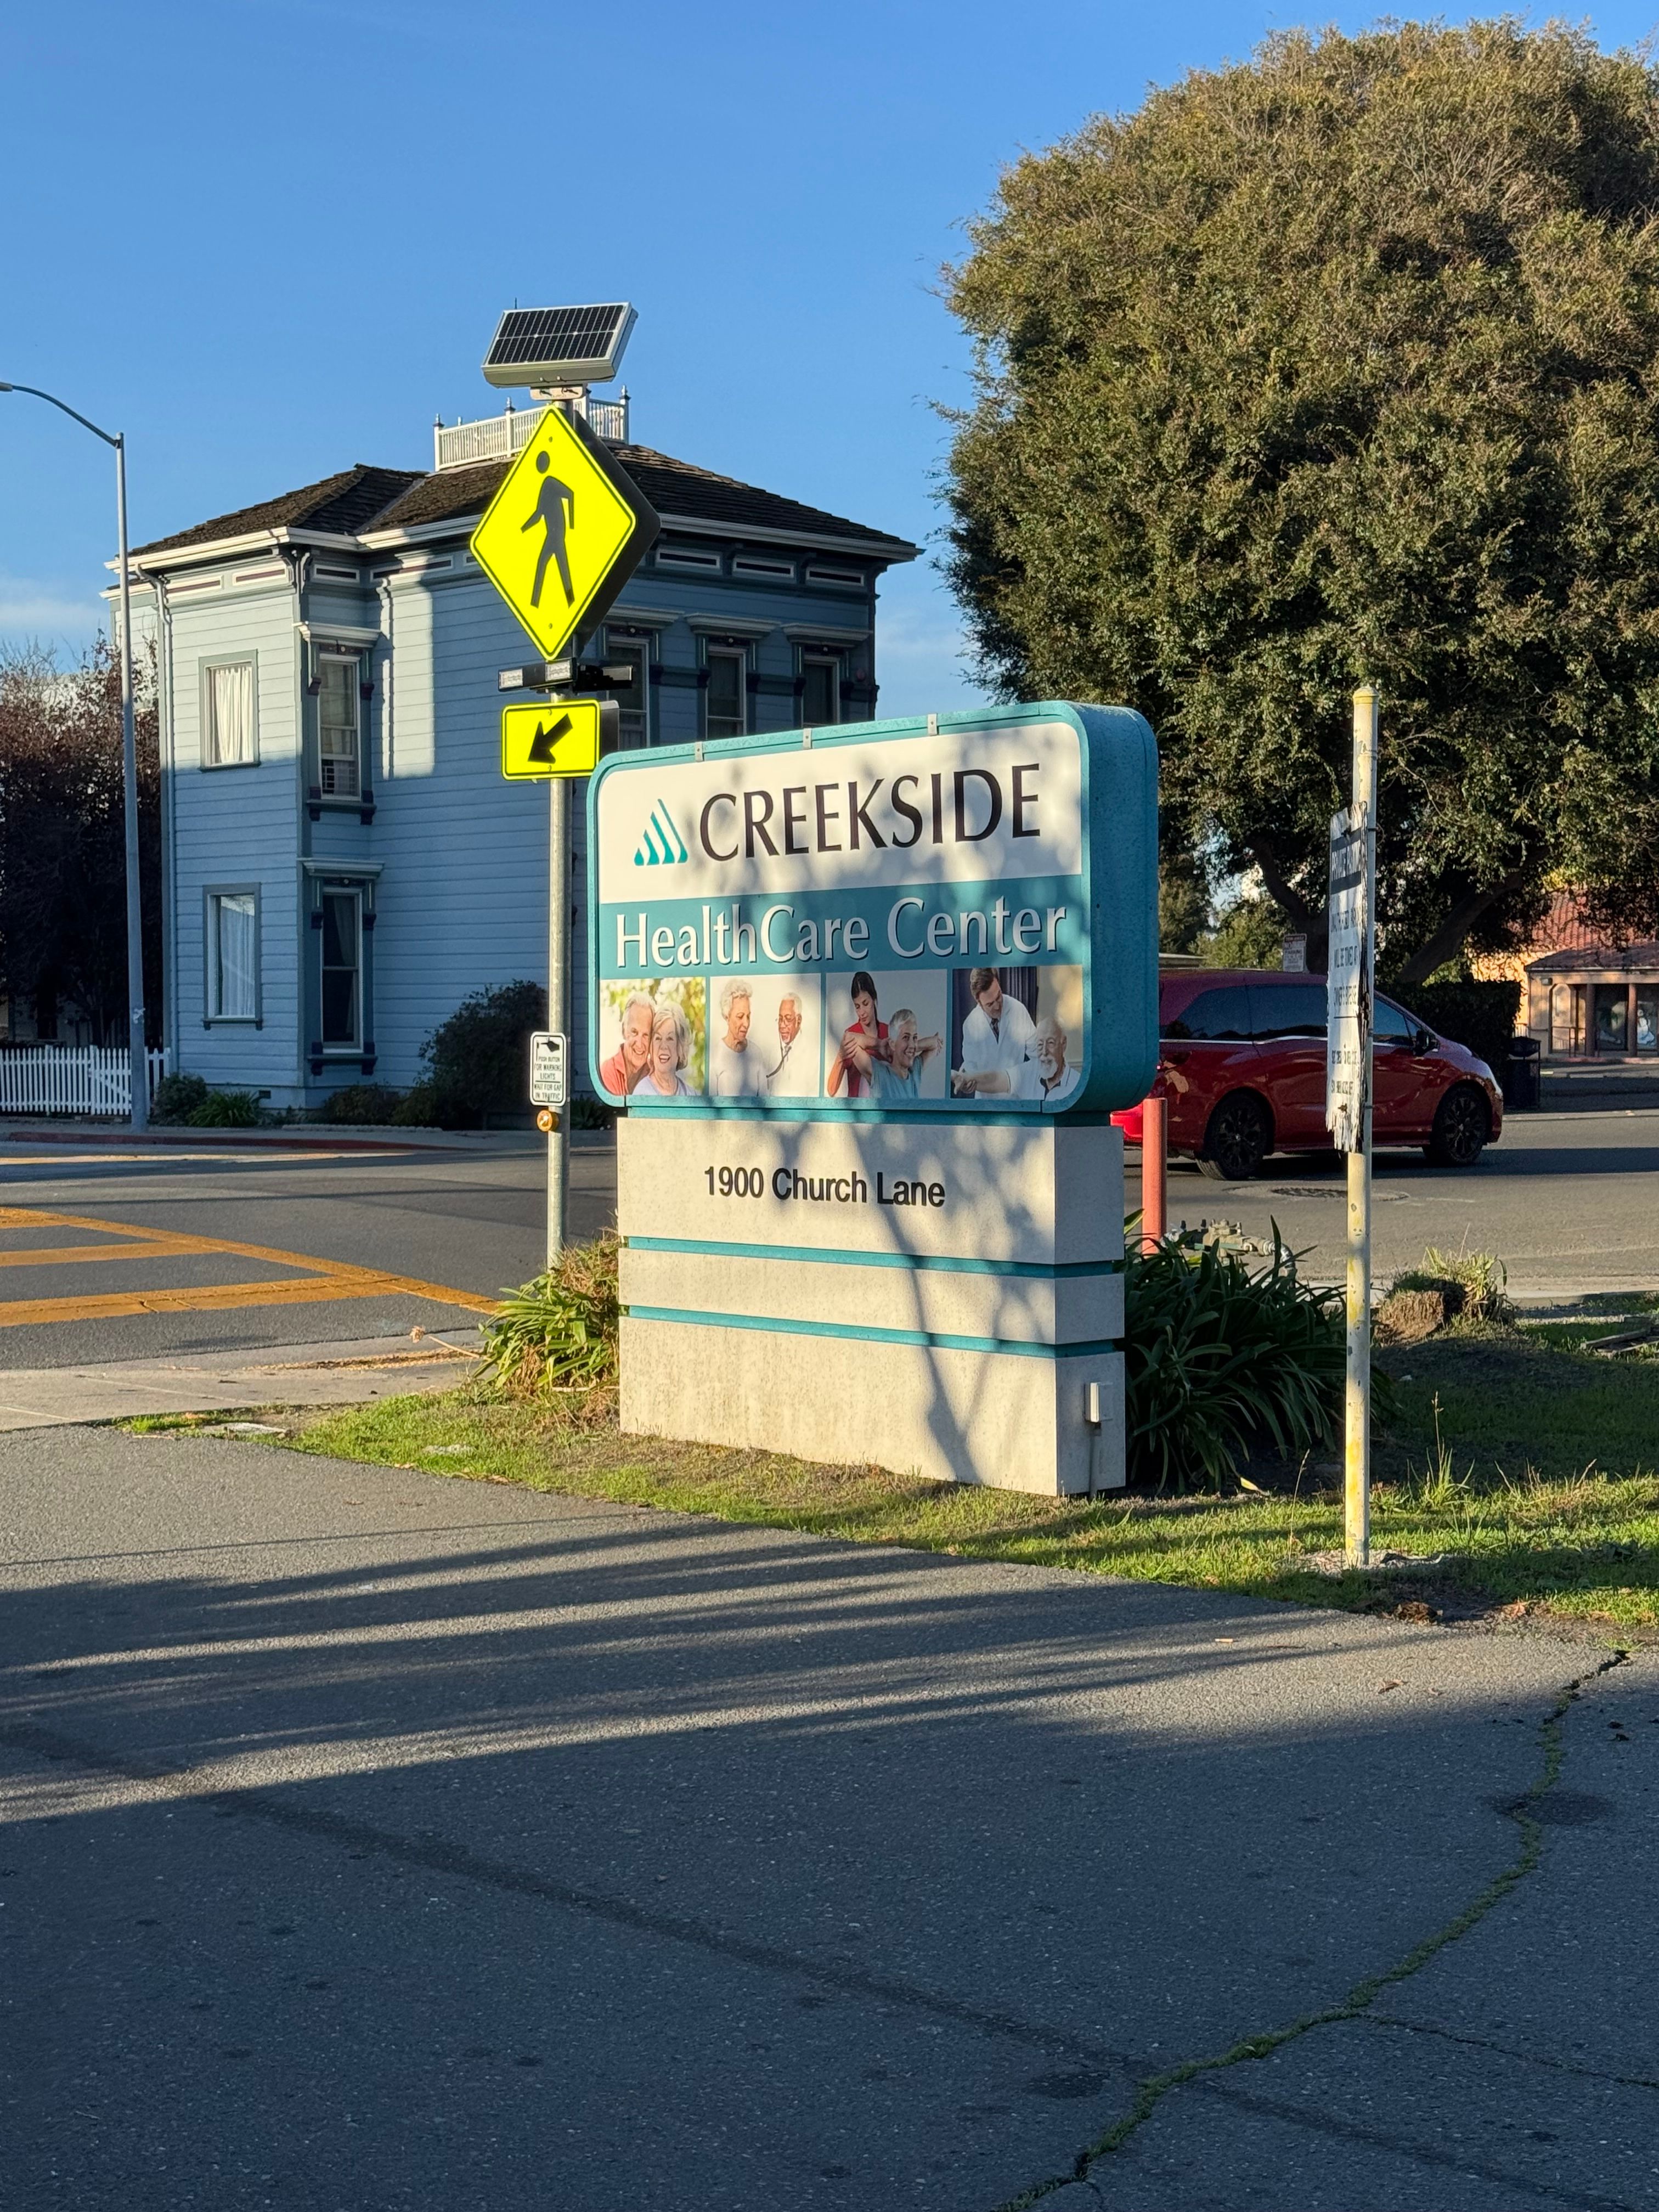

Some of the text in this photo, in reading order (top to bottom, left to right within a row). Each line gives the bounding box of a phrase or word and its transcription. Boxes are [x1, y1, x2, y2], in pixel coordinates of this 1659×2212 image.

[699, 763, 1041, 861] CREEKSIDE
[616, 895, 1067, 968] HealthCare Center
[704, 1165, 946, 1207] 1900 Church Lane
